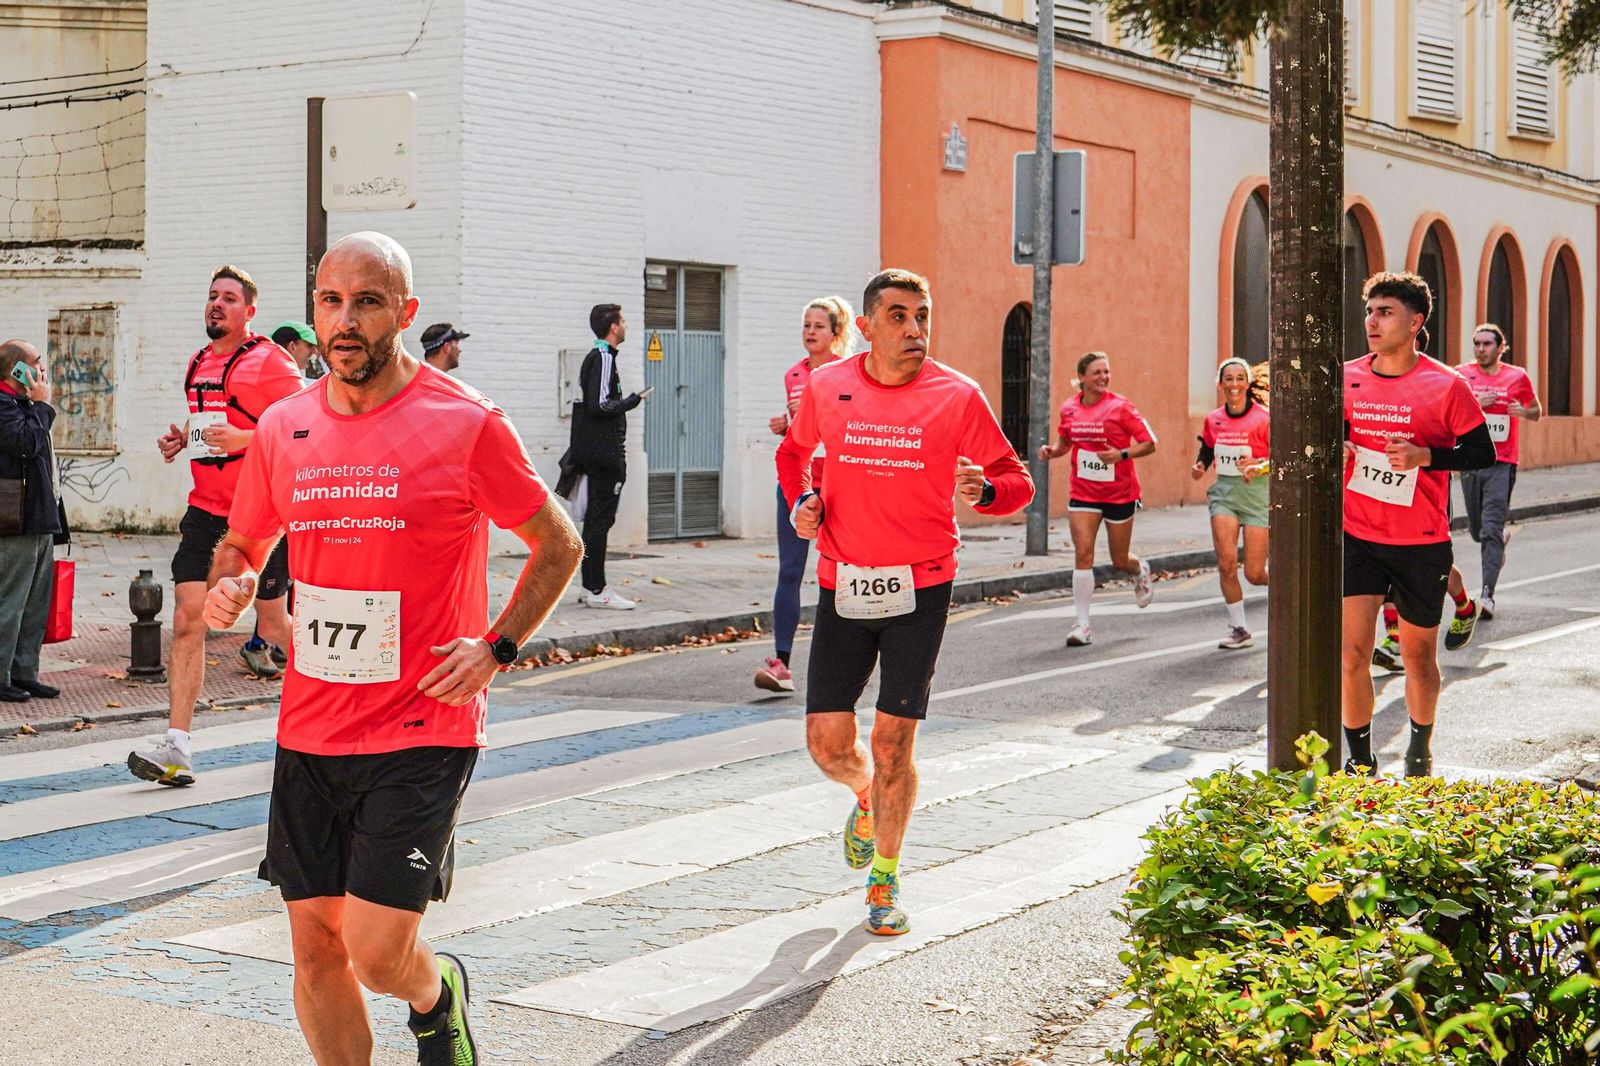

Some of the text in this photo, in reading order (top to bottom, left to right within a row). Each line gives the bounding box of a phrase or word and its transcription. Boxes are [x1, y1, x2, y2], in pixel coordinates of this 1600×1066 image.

[1352, 400, 1412, 413] kilómetros de
[1352, 410, 1411, 424] humanidad
[846, 420, 923, 436] kilómetros de
[844, 433, 922, 449] humanidad
[839, 455, 925, 469] #CarreraCruzRoja
[1082, 460, 1109, 471] 1484
[295, 463, 400, 482] kilómetros de
[1362, 465, 1407, 487] 1787
[292, 481, 399, 503] humanidad
[288, 516, 406, 533] #CarreraCruzRoja
[849, 577, 901, 596] 1266
[308, 618, 367, 650] 177
